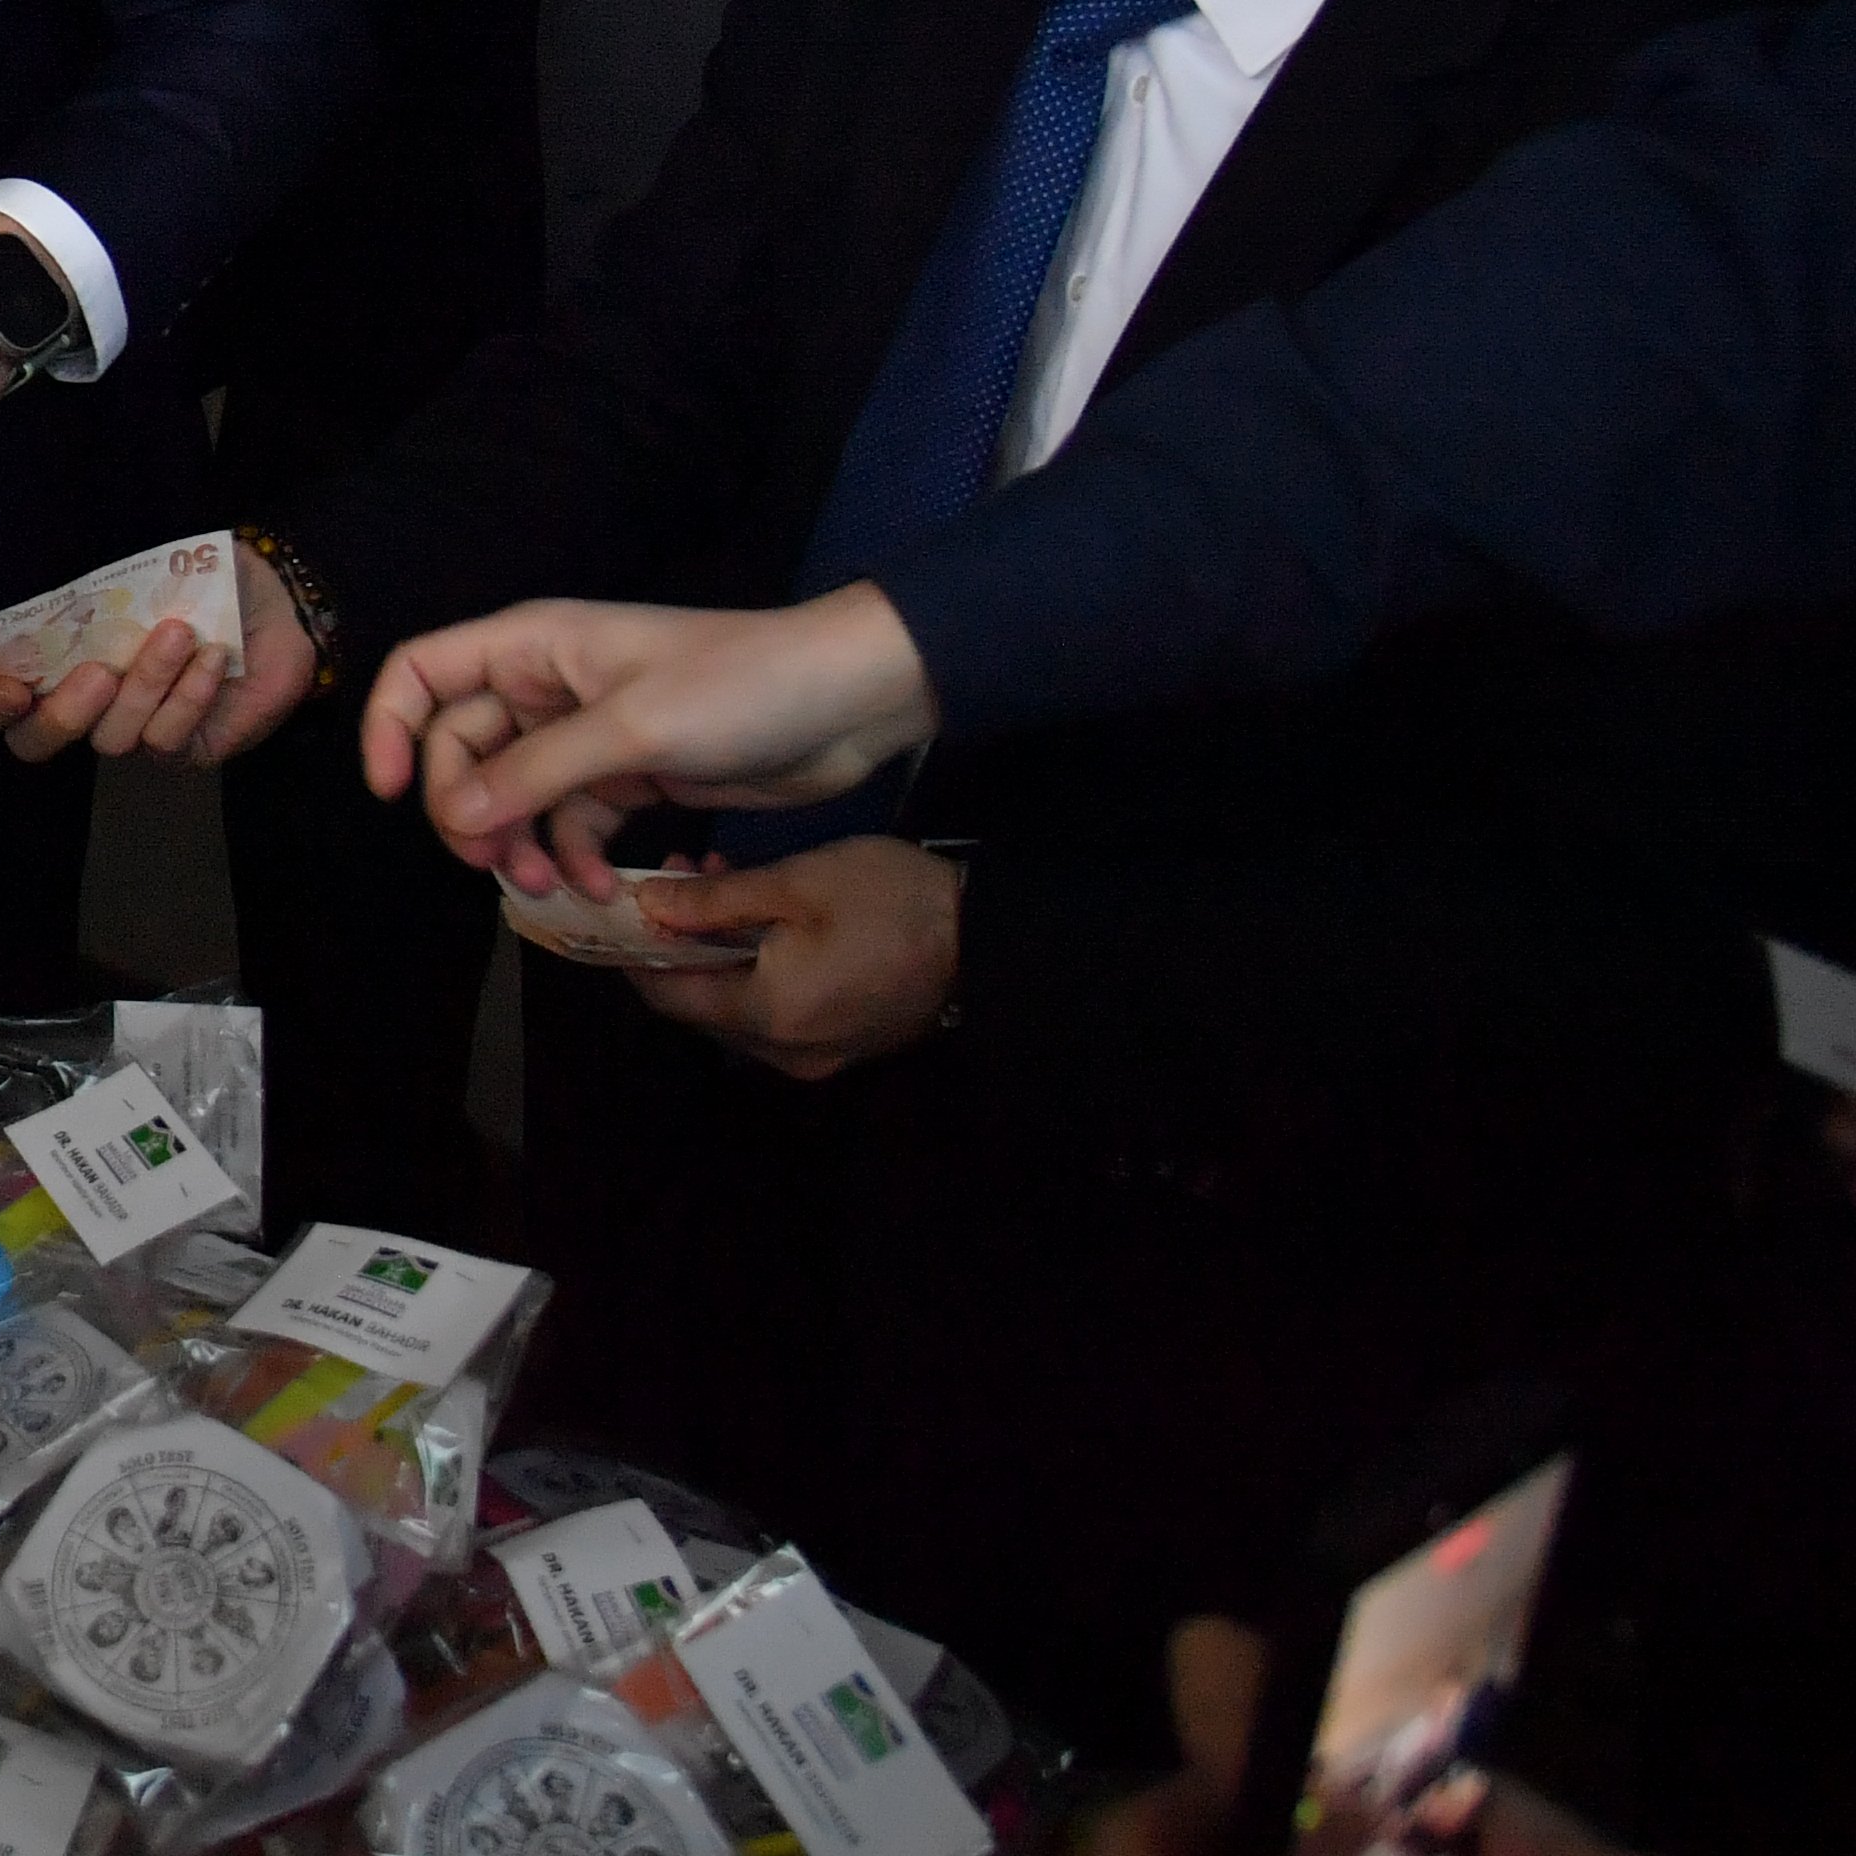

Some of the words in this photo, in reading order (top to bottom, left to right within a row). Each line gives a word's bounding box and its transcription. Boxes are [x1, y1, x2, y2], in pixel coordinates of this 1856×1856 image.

[169, 543, 220, 578] 50
[53, 1130, 70, 1150] DR.
[67, 1147, 99, 1184] HAKAN
[308, 1302, 364, 1328] HAKAN
[118, 1453, 155, 1474] SOLO
[158, 1450, 195, 1465] TEST
[542, 1552, 563, 1579] DR.
[559, 1582, 595, 1643] HAKAN
[760, 1701, 806, 1765] HAKAN
